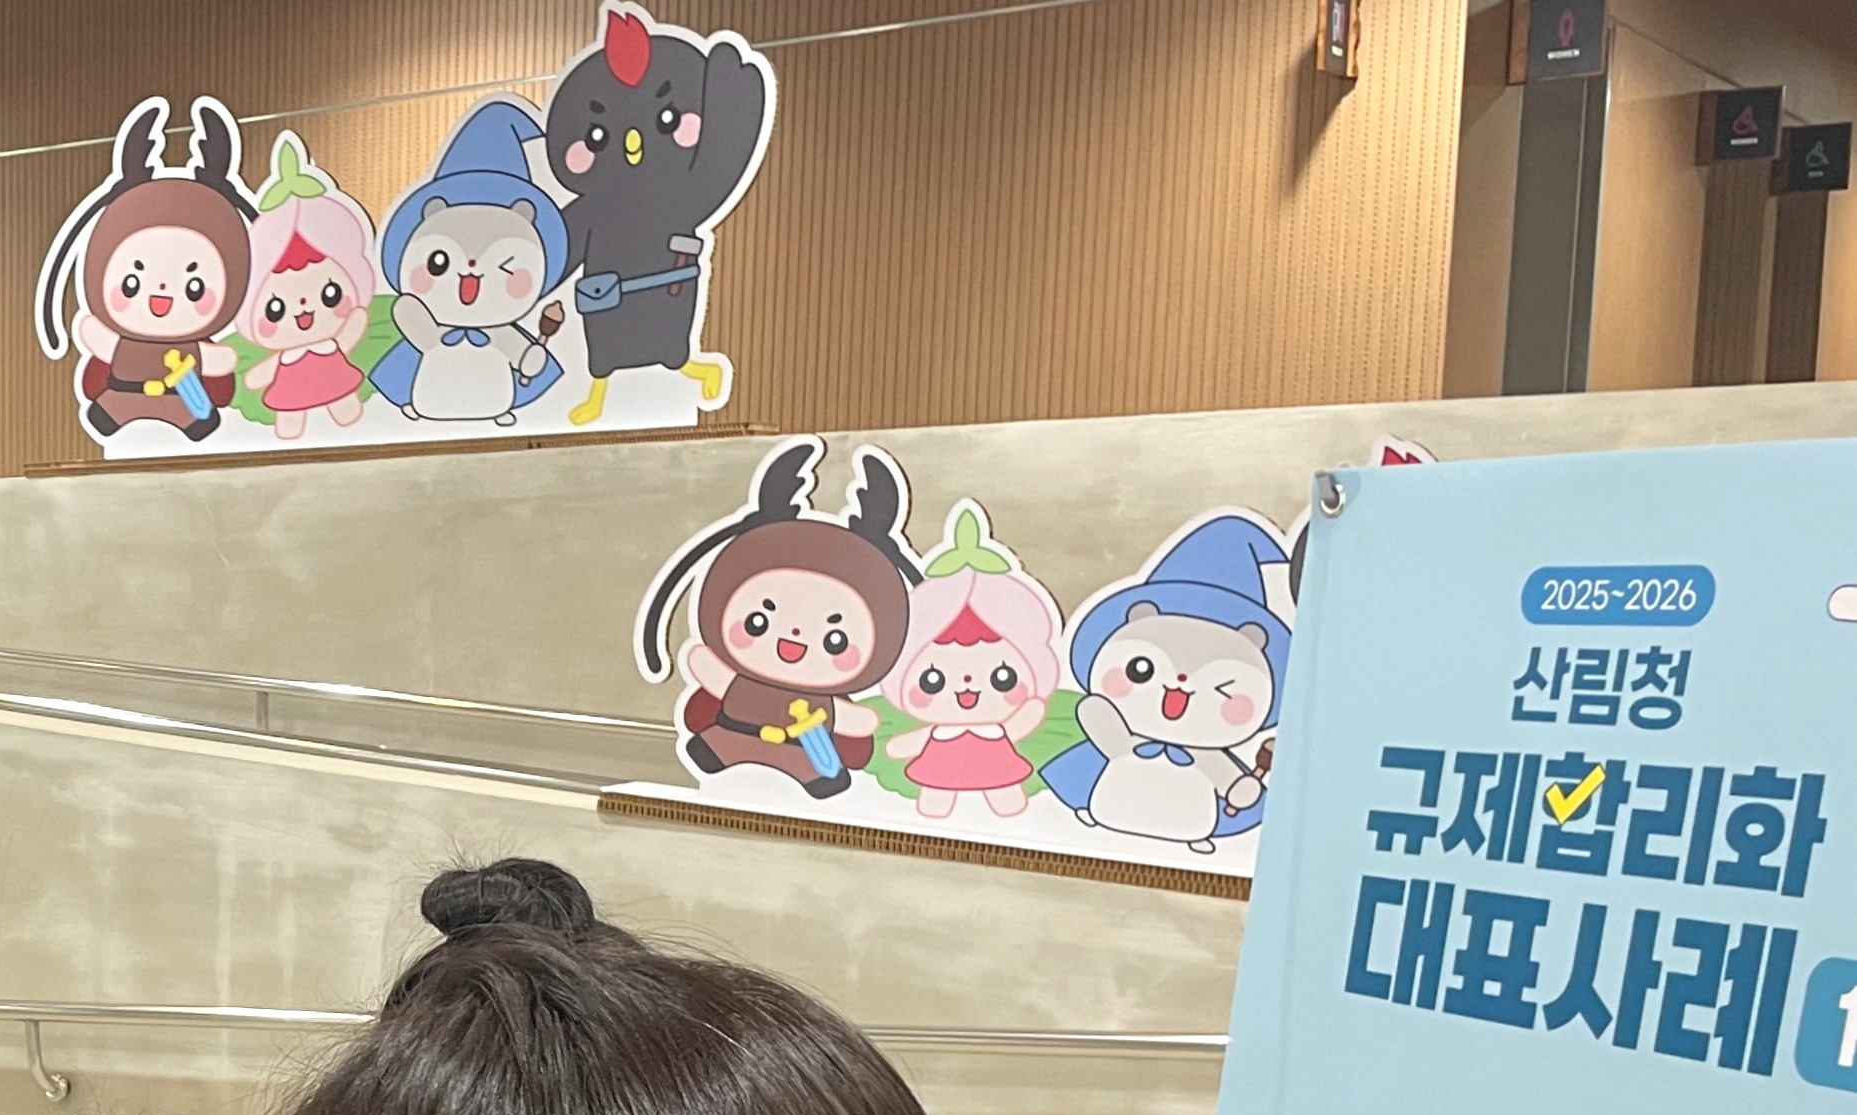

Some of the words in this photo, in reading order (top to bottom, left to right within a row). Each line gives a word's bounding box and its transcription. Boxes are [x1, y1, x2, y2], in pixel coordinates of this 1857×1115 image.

[1540, 578, 1698, 612] 2025~2026
[1510, 645, 1693, 731] 산림청
[1366, 745, 1829, 898] 규제합리화
[1344, 874, 1799, 1078] 대표사례
[1837, 984, 1857, 1068] 1
